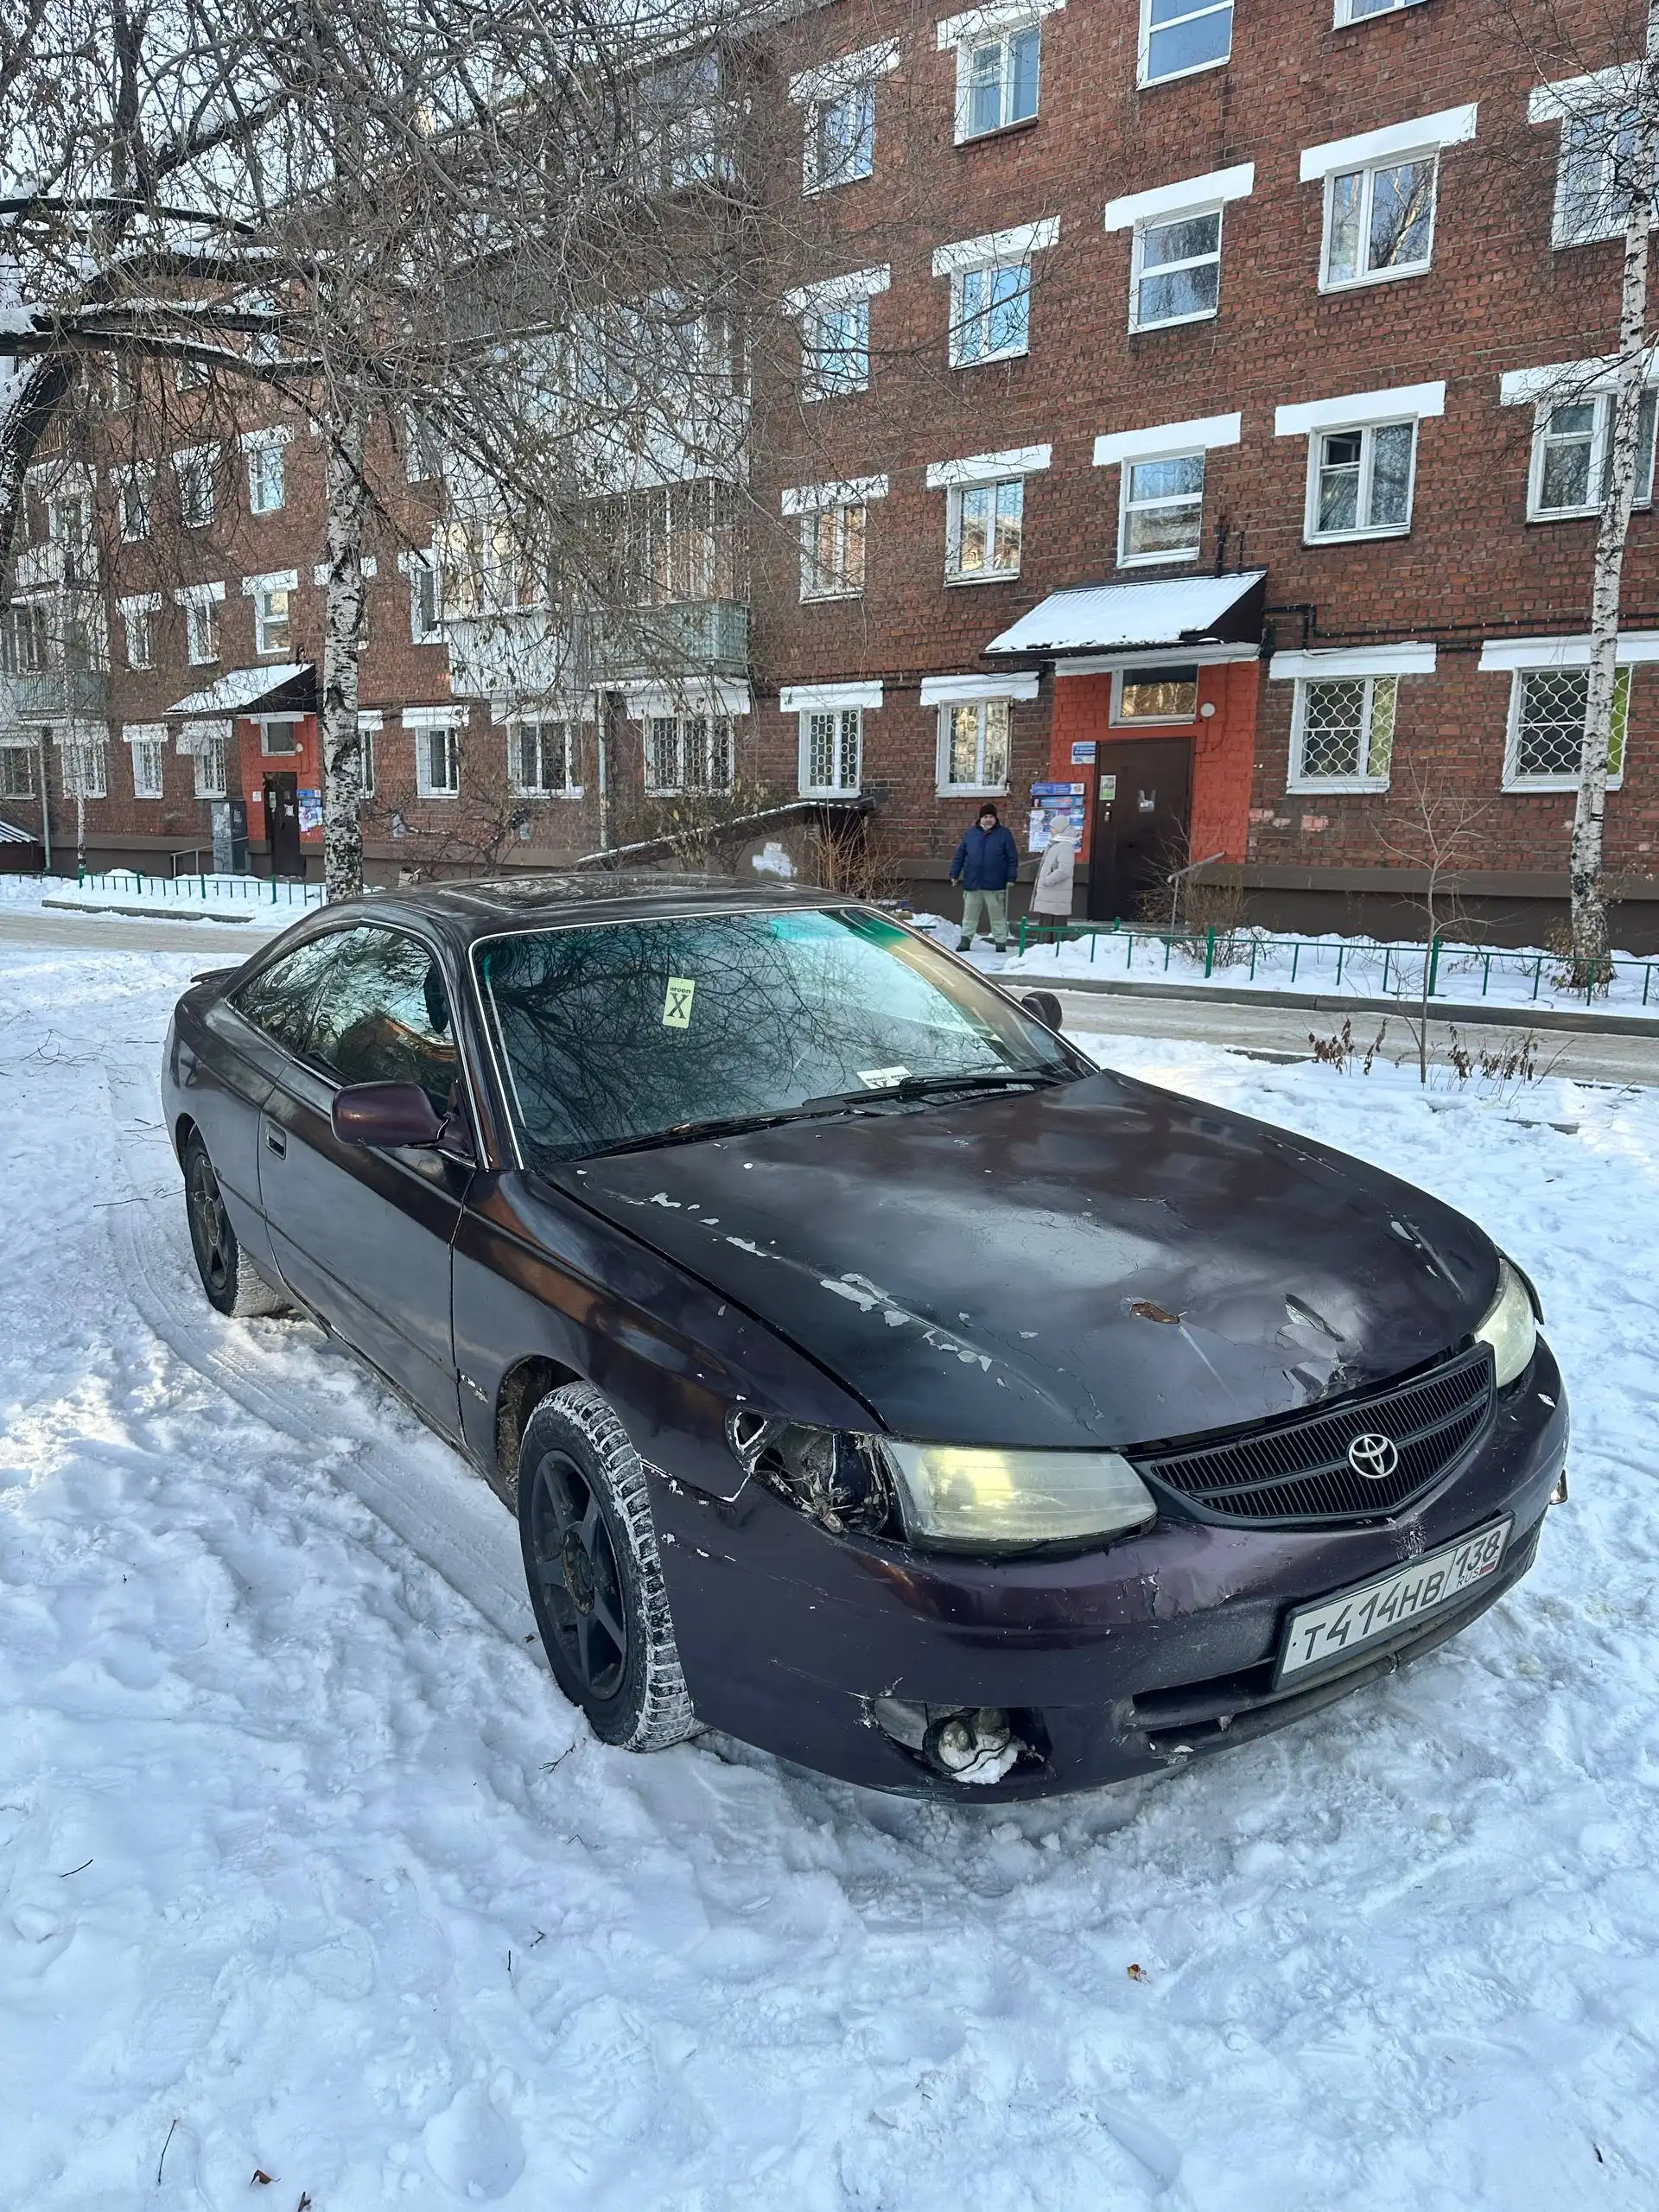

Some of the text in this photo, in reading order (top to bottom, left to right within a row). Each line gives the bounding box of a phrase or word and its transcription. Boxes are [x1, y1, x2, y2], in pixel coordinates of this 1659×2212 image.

[666, 992, 690, 1020] X
[1456, 1530, 1500, 1578] 138
[1456, 1567, 1479, 1588] RUS
